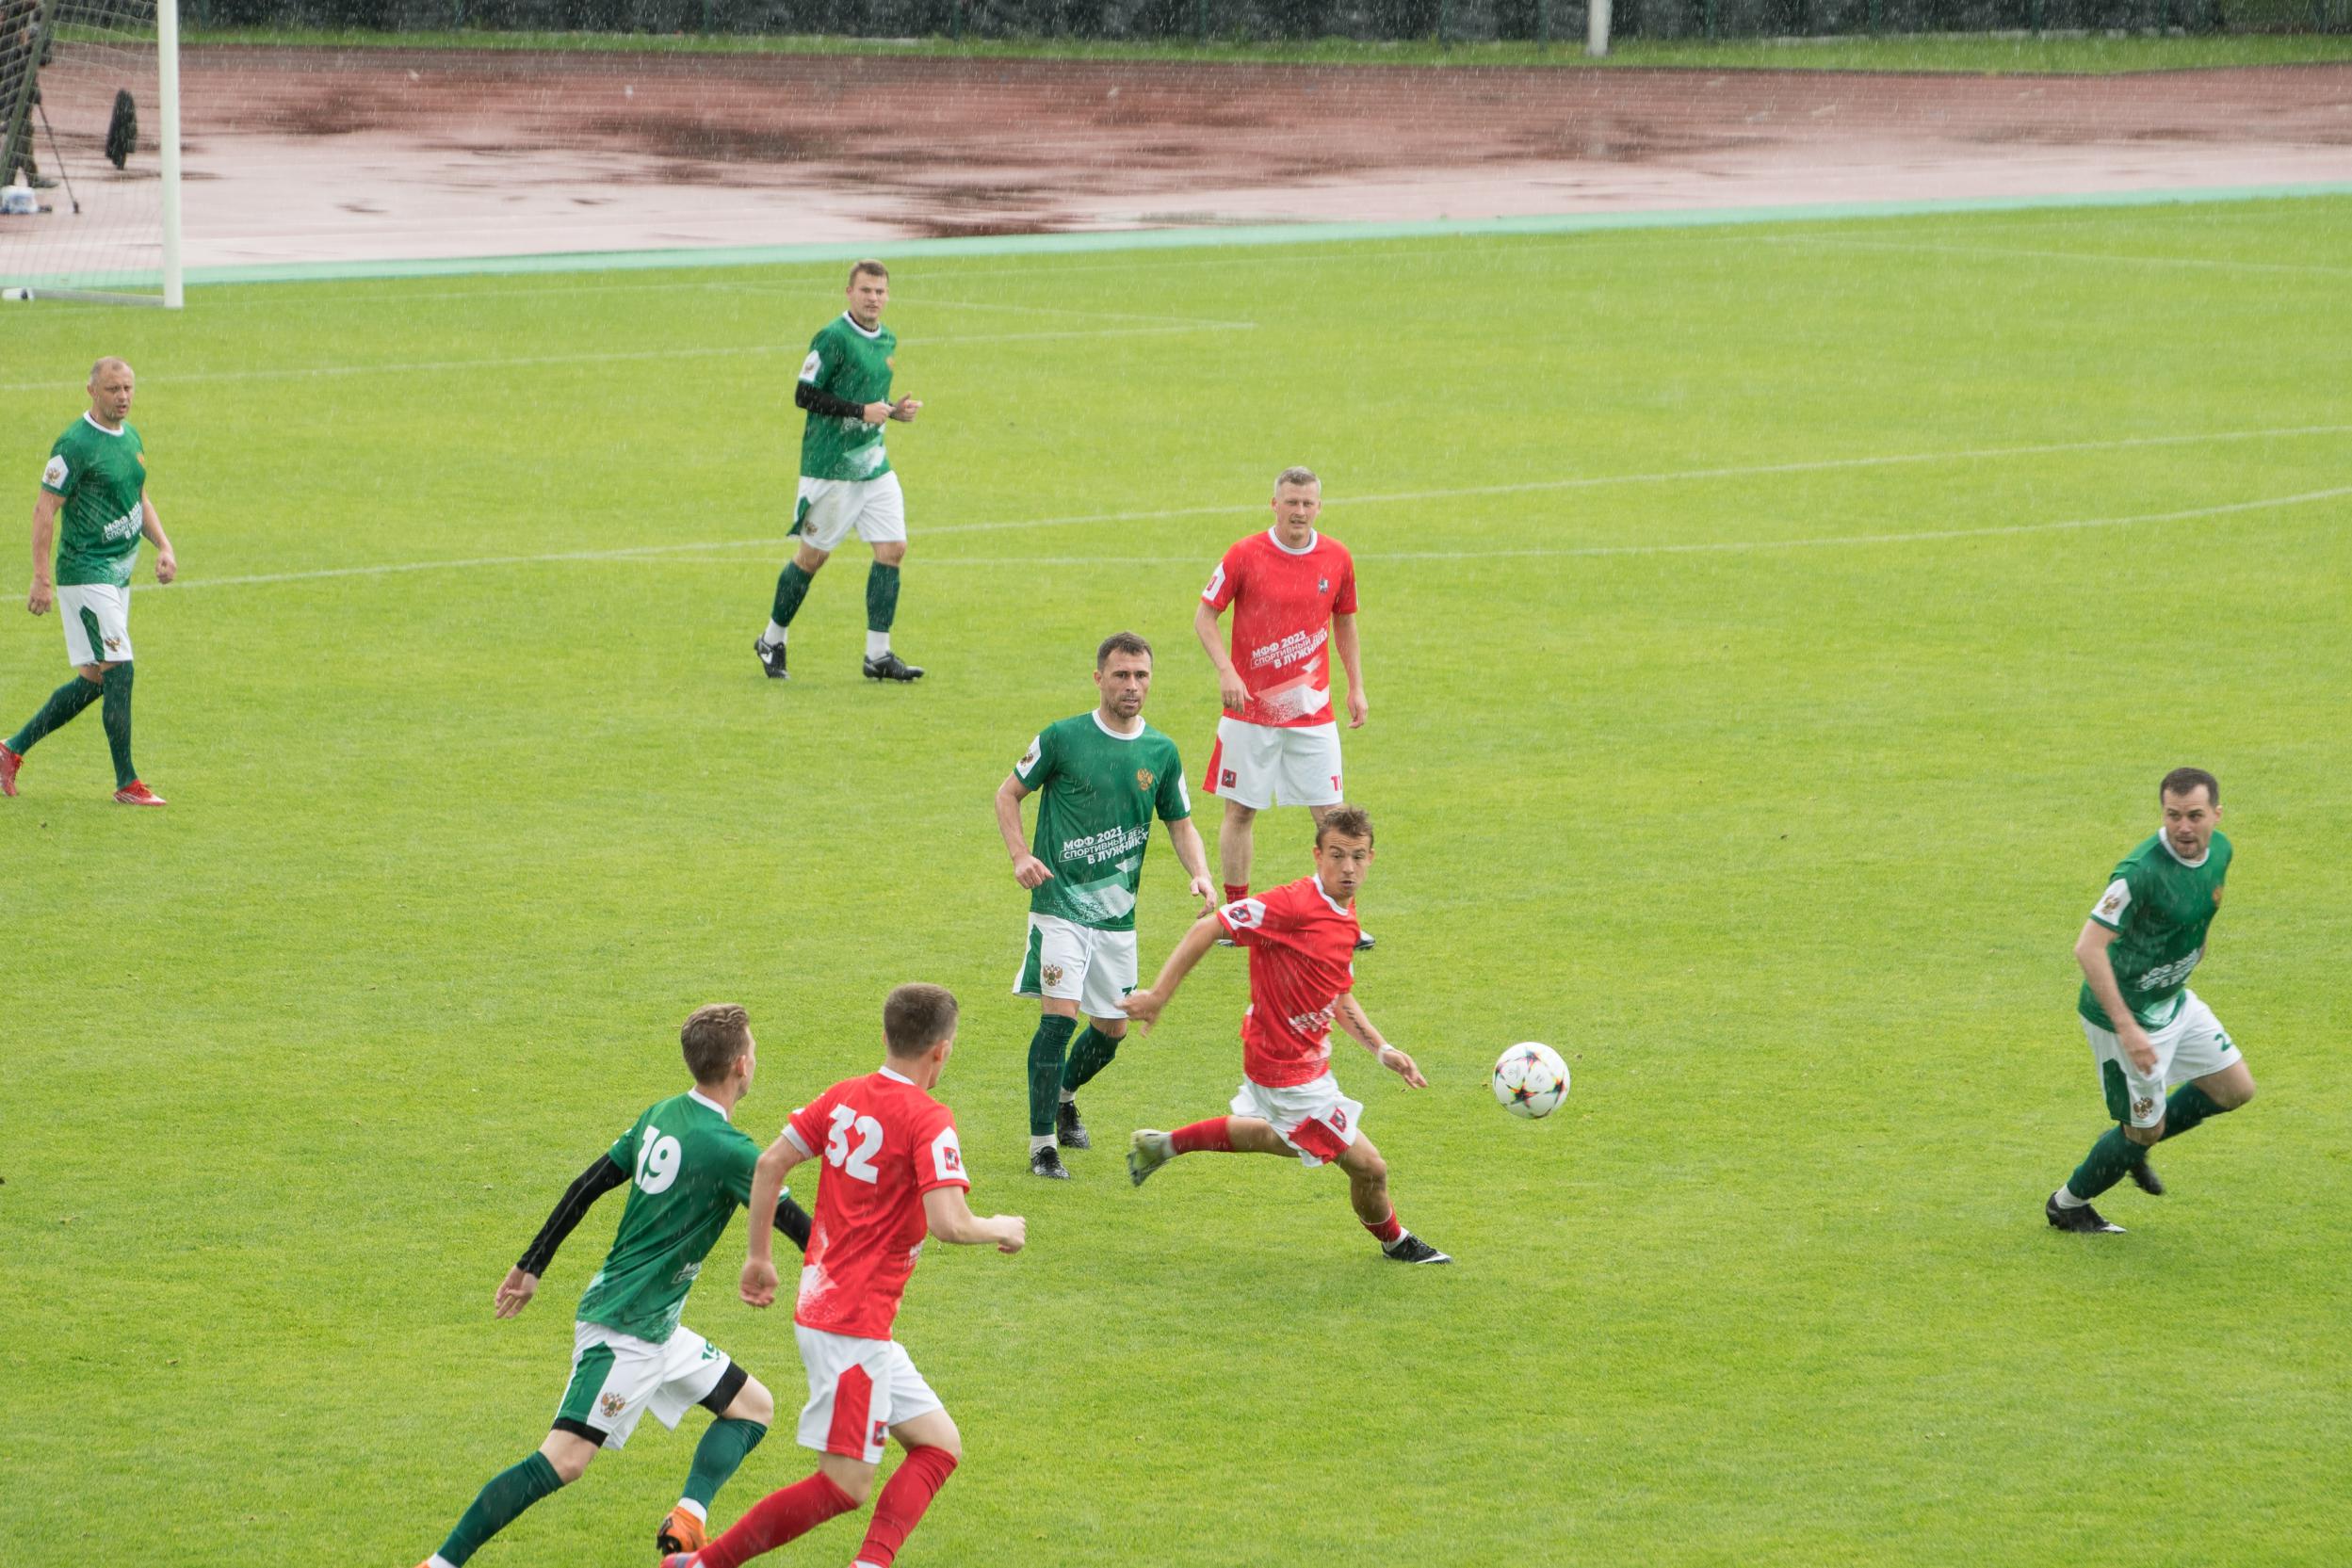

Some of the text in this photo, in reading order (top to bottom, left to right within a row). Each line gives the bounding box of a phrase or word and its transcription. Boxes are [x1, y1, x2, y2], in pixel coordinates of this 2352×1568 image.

[1252, 630, 1306, 658] МФФ 2023
[1254, 638, 1311, 666] СПОРТИВНЫЙ
[1273, 658, 1282, 669] В
[1063, 826, 1122, 851] МФФ 2023
[1063, 832, 1127, 859] СПОРТИВНЫЙ
[1087, 854, 1095, 865] В
[824, 1104, 884, 1184] 32
[635, 1124, 681, 1195] 19
